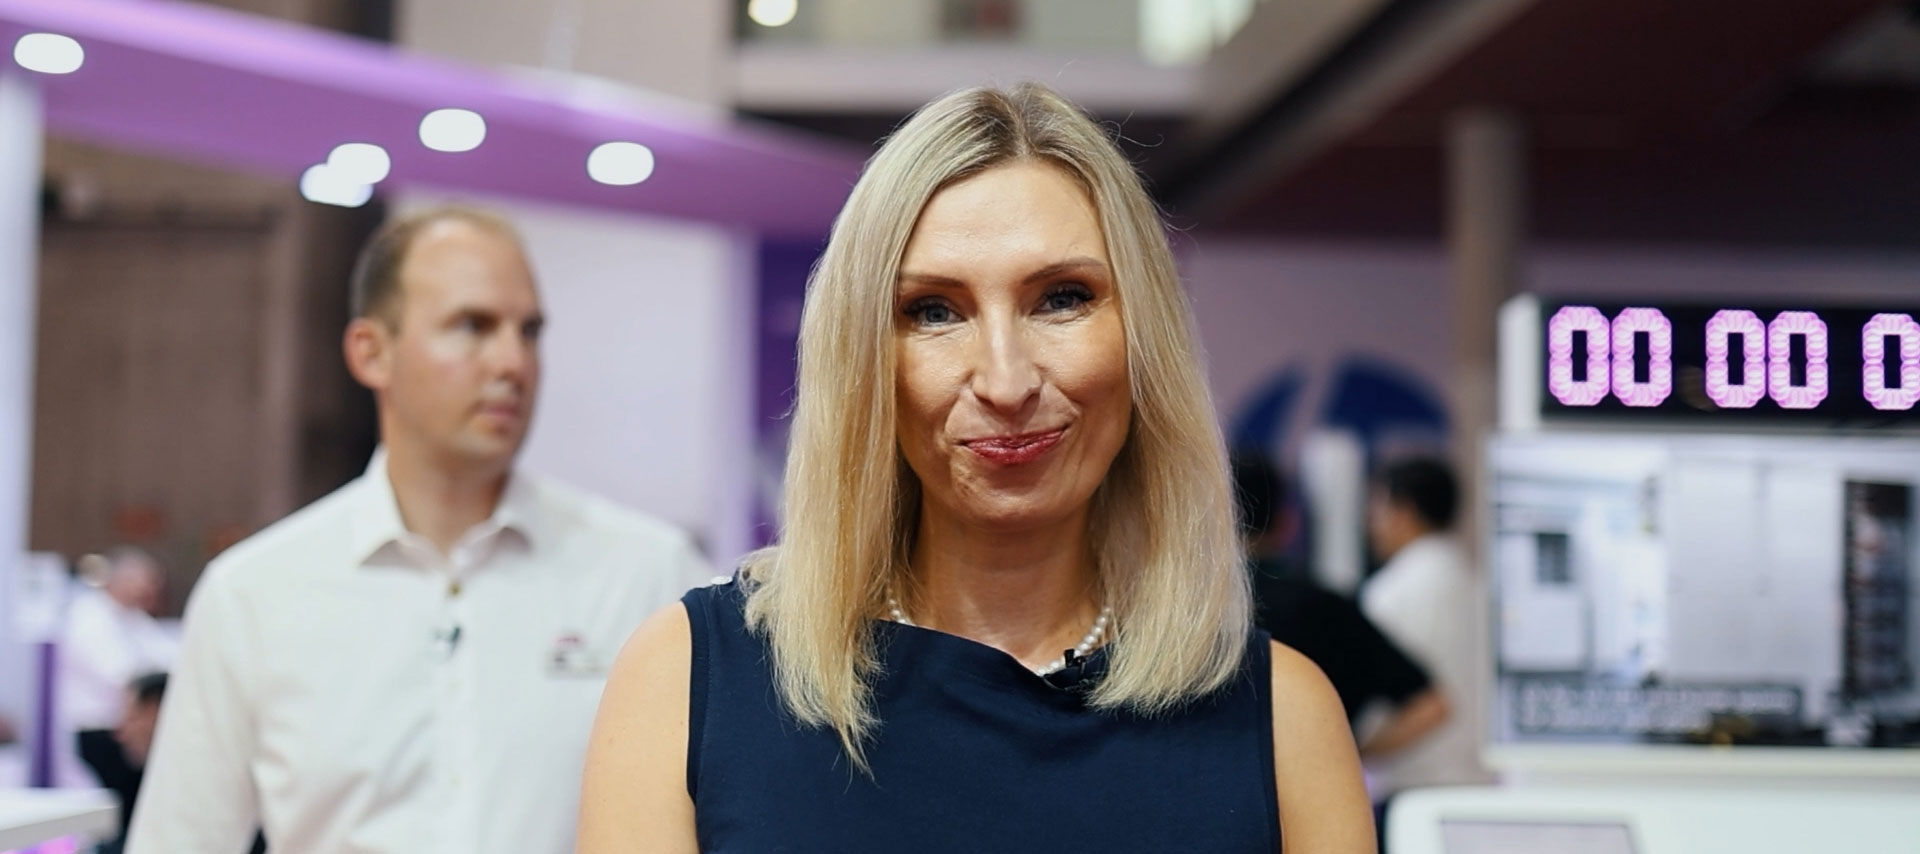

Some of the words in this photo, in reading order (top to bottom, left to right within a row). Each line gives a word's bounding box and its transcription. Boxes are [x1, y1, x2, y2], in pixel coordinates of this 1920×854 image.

[1549, 306, 1672, 407] 00
[1705, 310, 1828, 410] 00
[1862, 313, 1920, 411] 0
